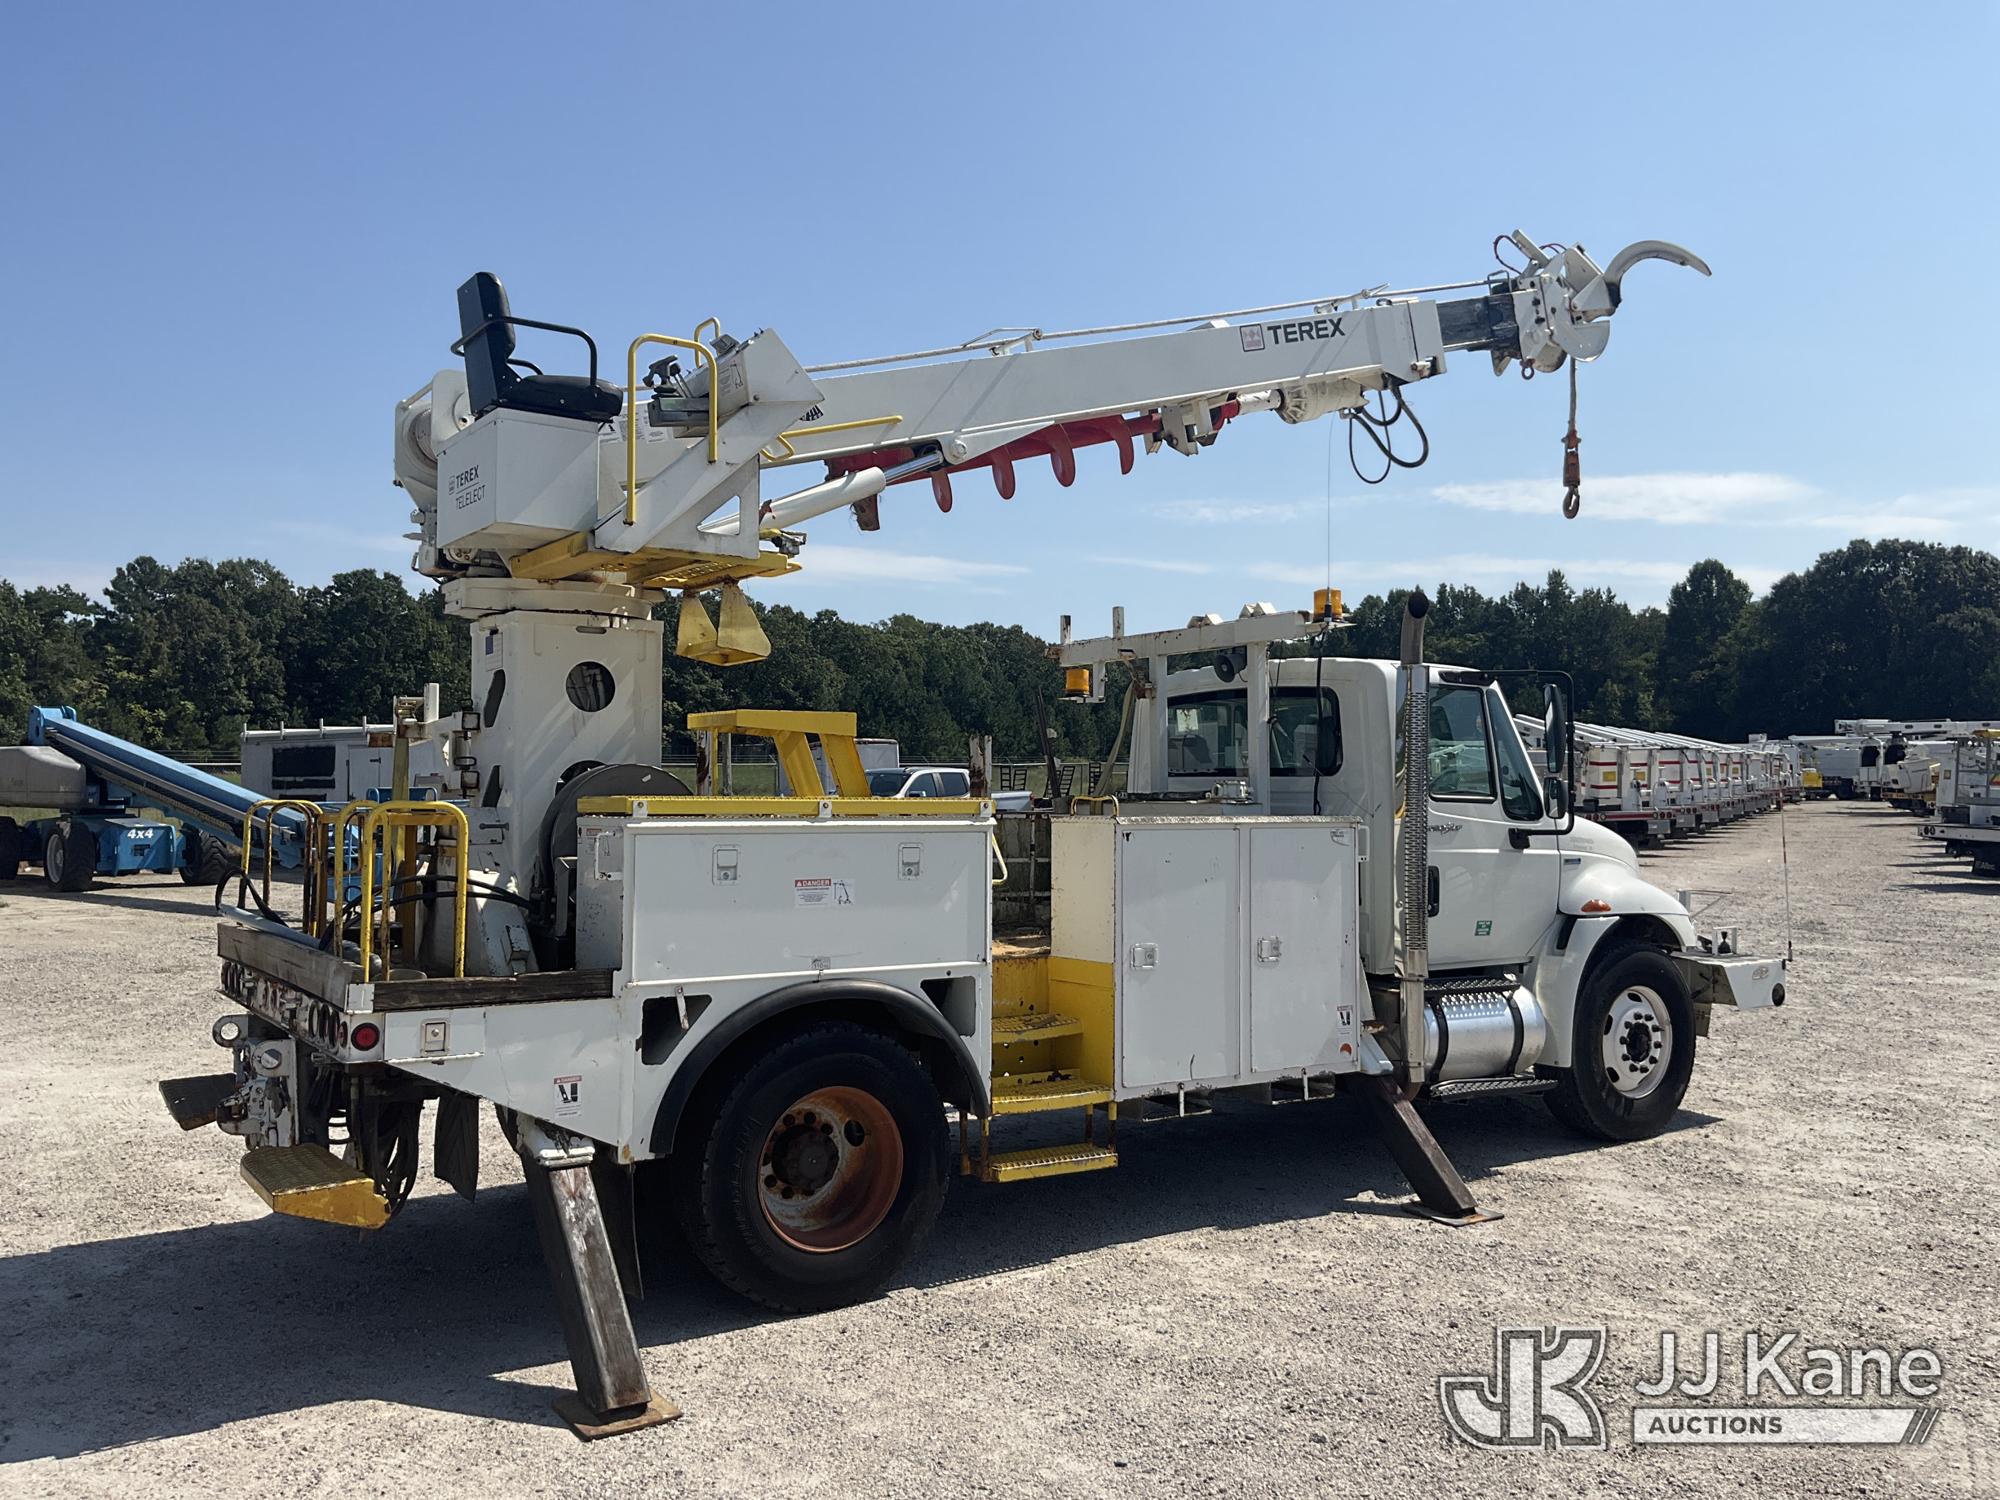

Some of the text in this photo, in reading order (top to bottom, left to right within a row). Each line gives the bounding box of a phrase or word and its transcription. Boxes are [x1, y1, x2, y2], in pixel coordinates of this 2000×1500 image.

[1267, 317, 1346, 345] TEREX
[455, 464, 479, 489] TEREX
[455, 484, 486, 511] TELELECT
[127, 827, 154, 839] 4x4
